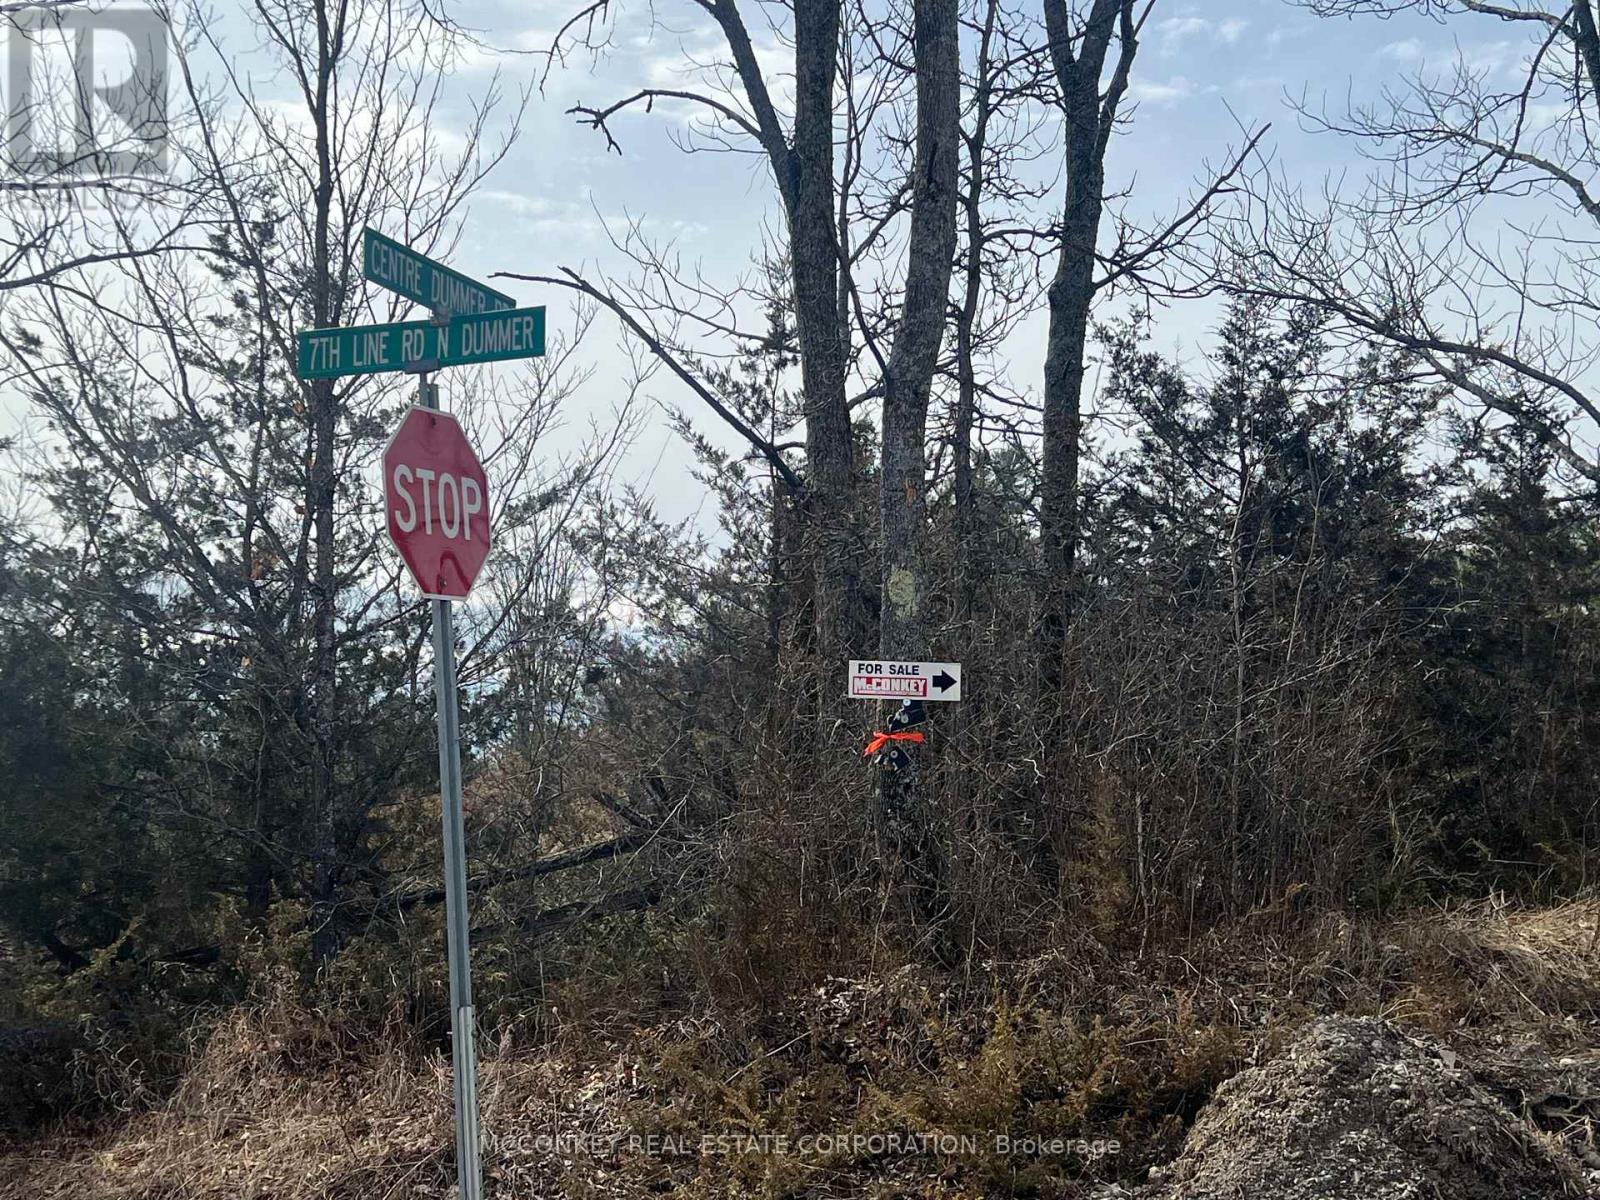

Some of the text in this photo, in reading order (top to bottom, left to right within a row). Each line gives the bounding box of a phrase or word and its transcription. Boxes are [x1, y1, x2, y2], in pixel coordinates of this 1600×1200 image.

[371, 240, 423, 296] CENTRE
[431, 270, 486, 314] DUMMER
[308, 316, 534, 370] 7TH LINE RD N DUMMER
[393, 464, 482, 541] STOP
[858, 663, 920, 675] FOR SALE
